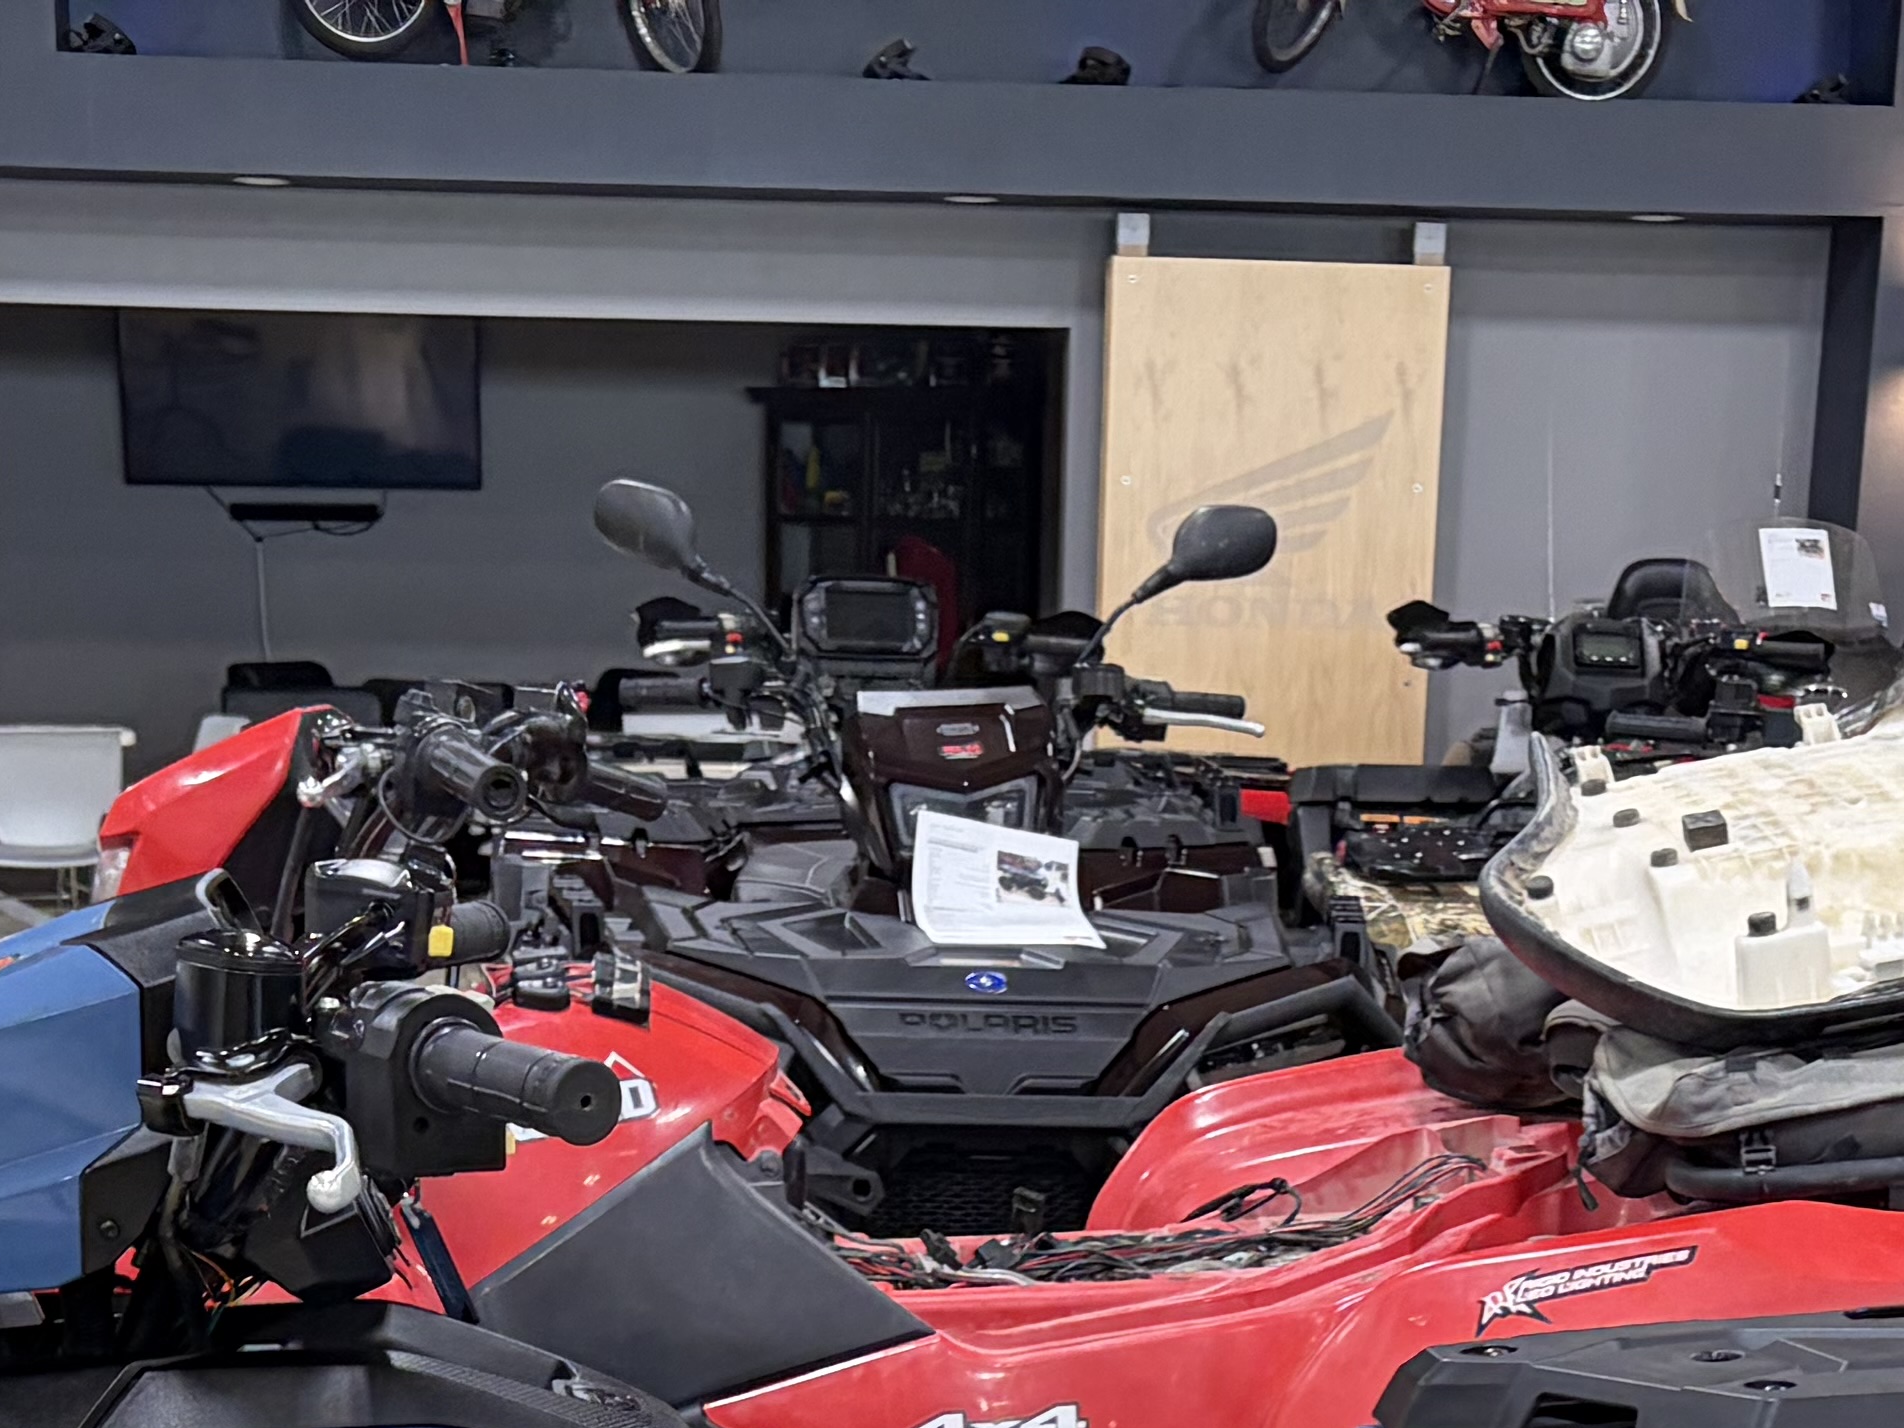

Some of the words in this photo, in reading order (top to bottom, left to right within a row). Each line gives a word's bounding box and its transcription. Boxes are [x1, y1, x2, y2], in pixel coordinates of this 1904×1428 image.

[899, 1012, 1077, 1035] POLARIS
[1573, 1249, 1692, 1280] INDUSTRIES
[1556, 1267, 1648, 1294] LIGHTING
